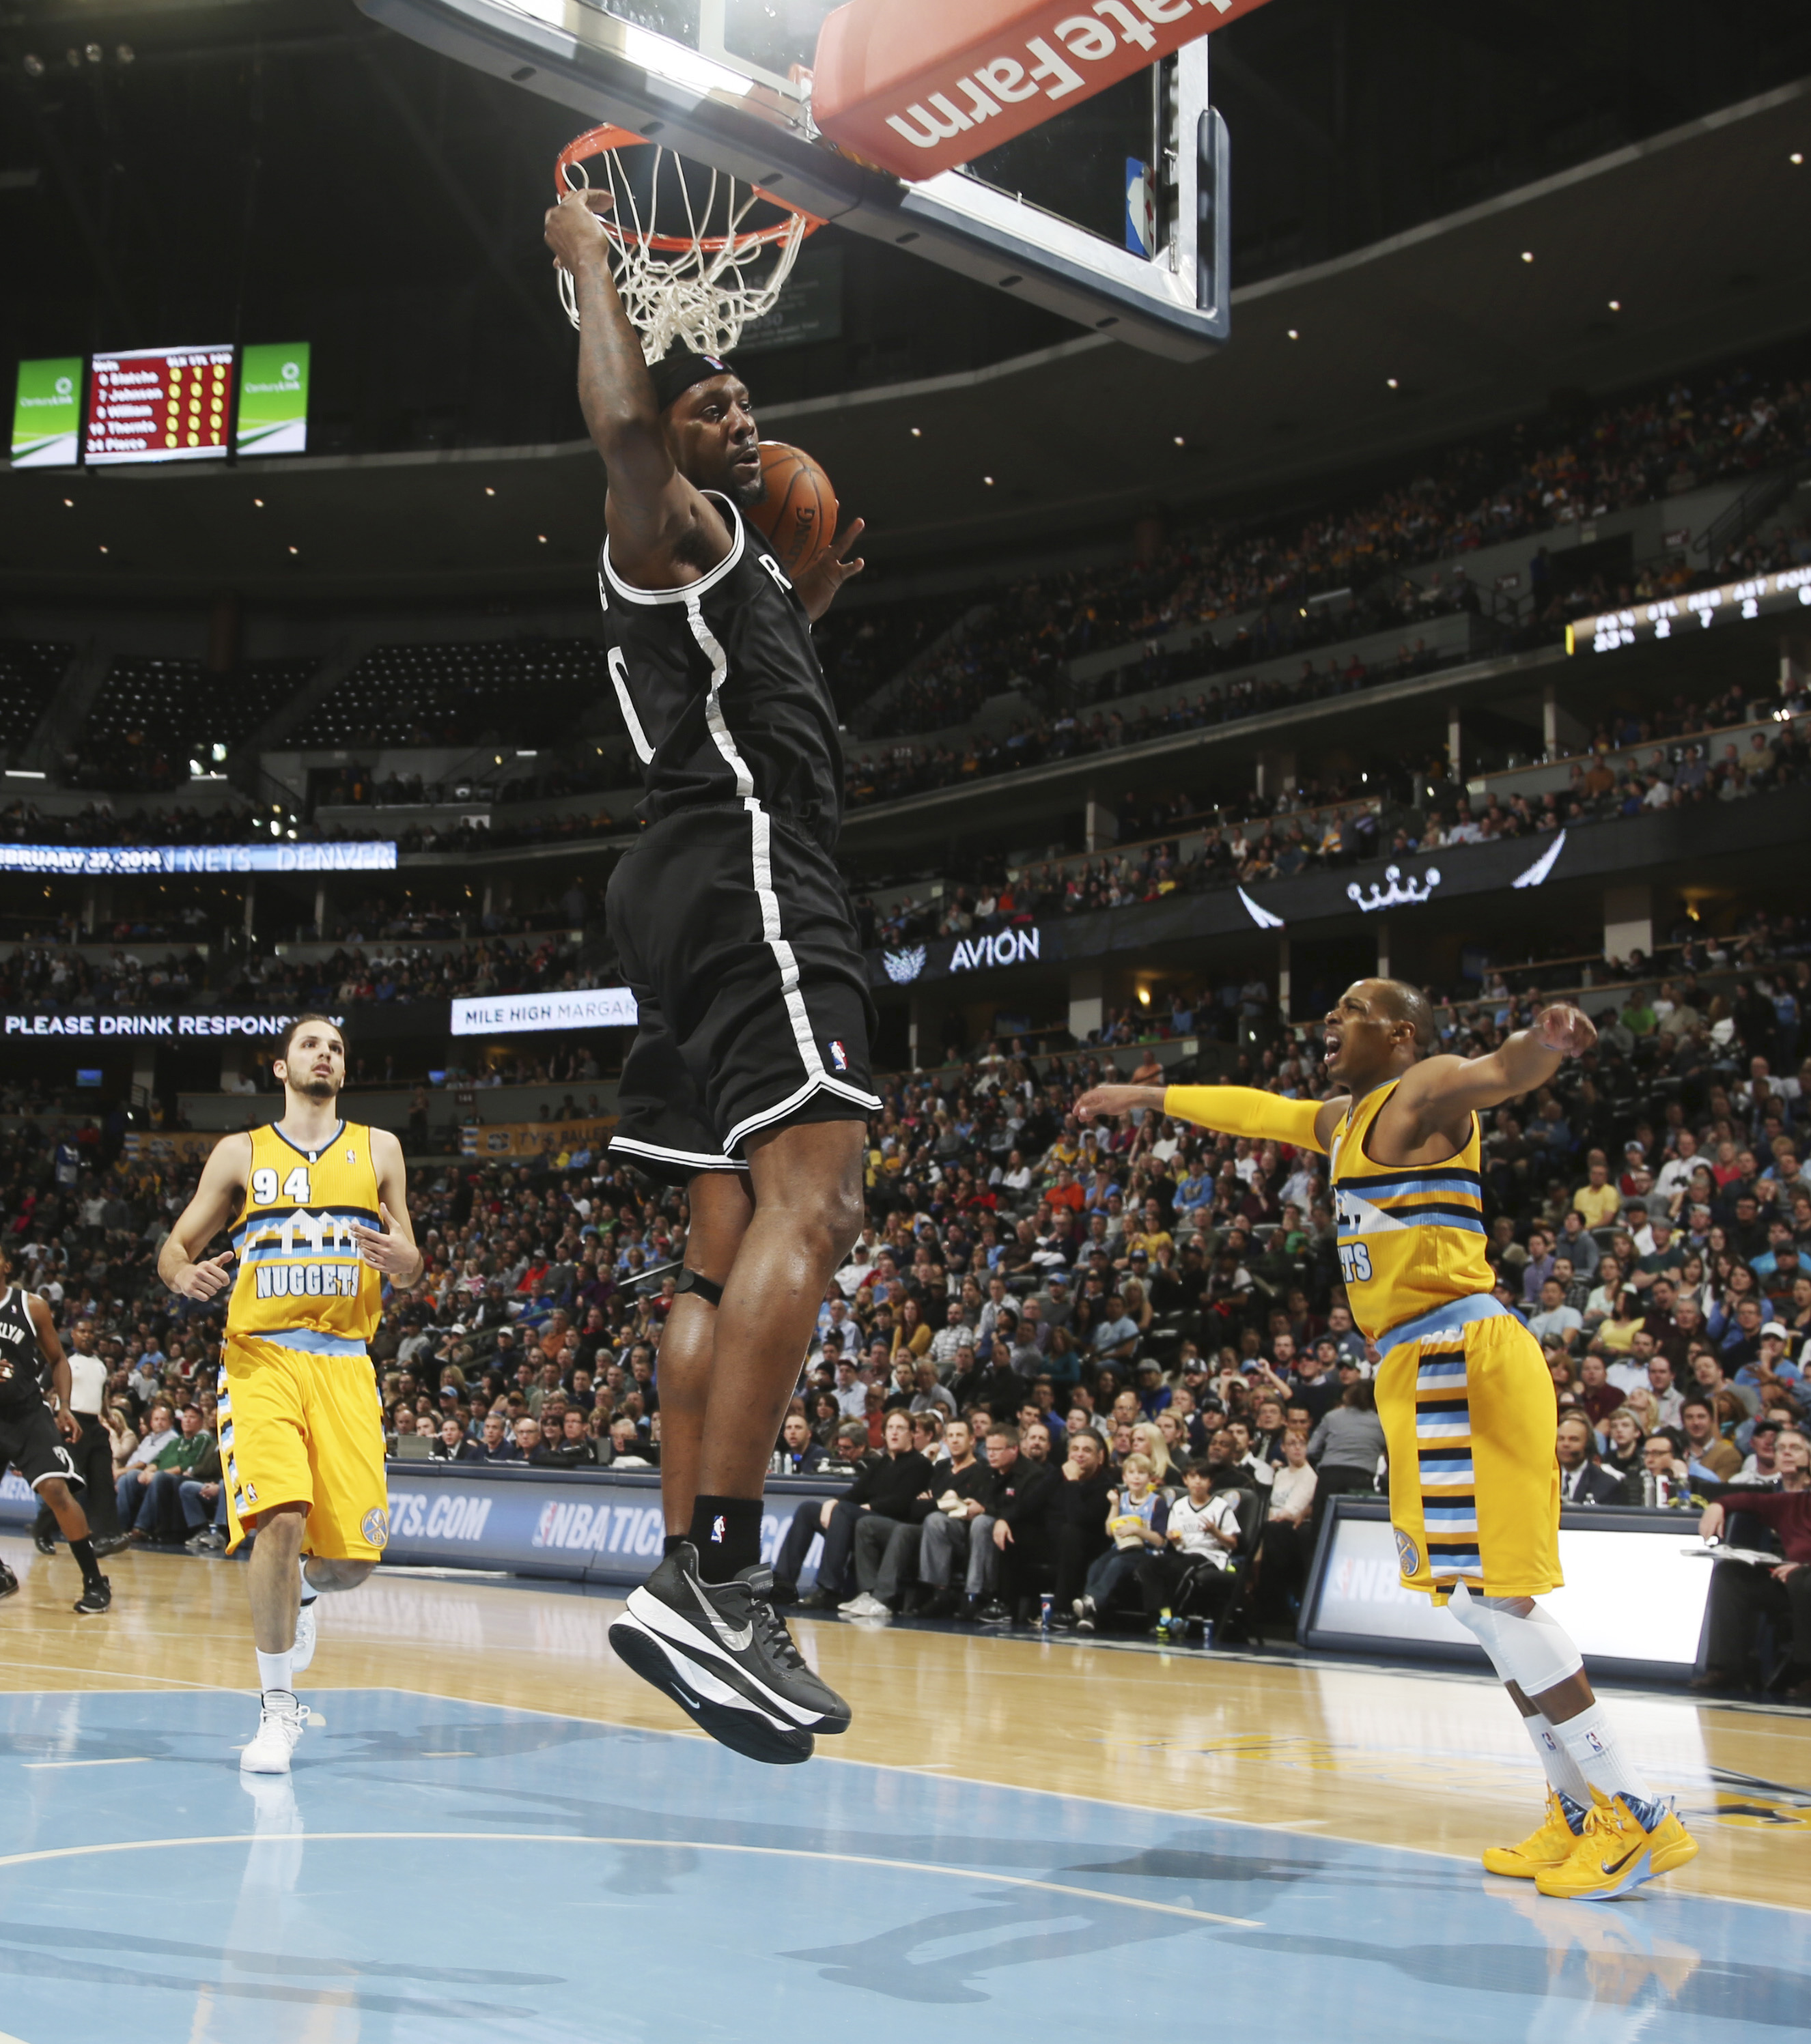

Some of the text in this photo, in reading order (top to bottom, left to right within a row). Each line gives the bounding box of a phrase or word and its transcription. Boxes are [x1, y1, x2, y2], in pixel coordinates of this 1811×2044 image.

[184, 844, 396, 872] NETS DENVER
[5, 1016, 94, 1034] PLEASE
[100, 1015, 173, 1034] DRINK
[466, 1009, 504, 1024] MILE
[510, 1005, 550, 1022] HIGH
[253, 1167, 311, 1205] 94
[1338, 1242, 1373, 1283] TS
[256, 1264, 360, 1299] NUGGETS
